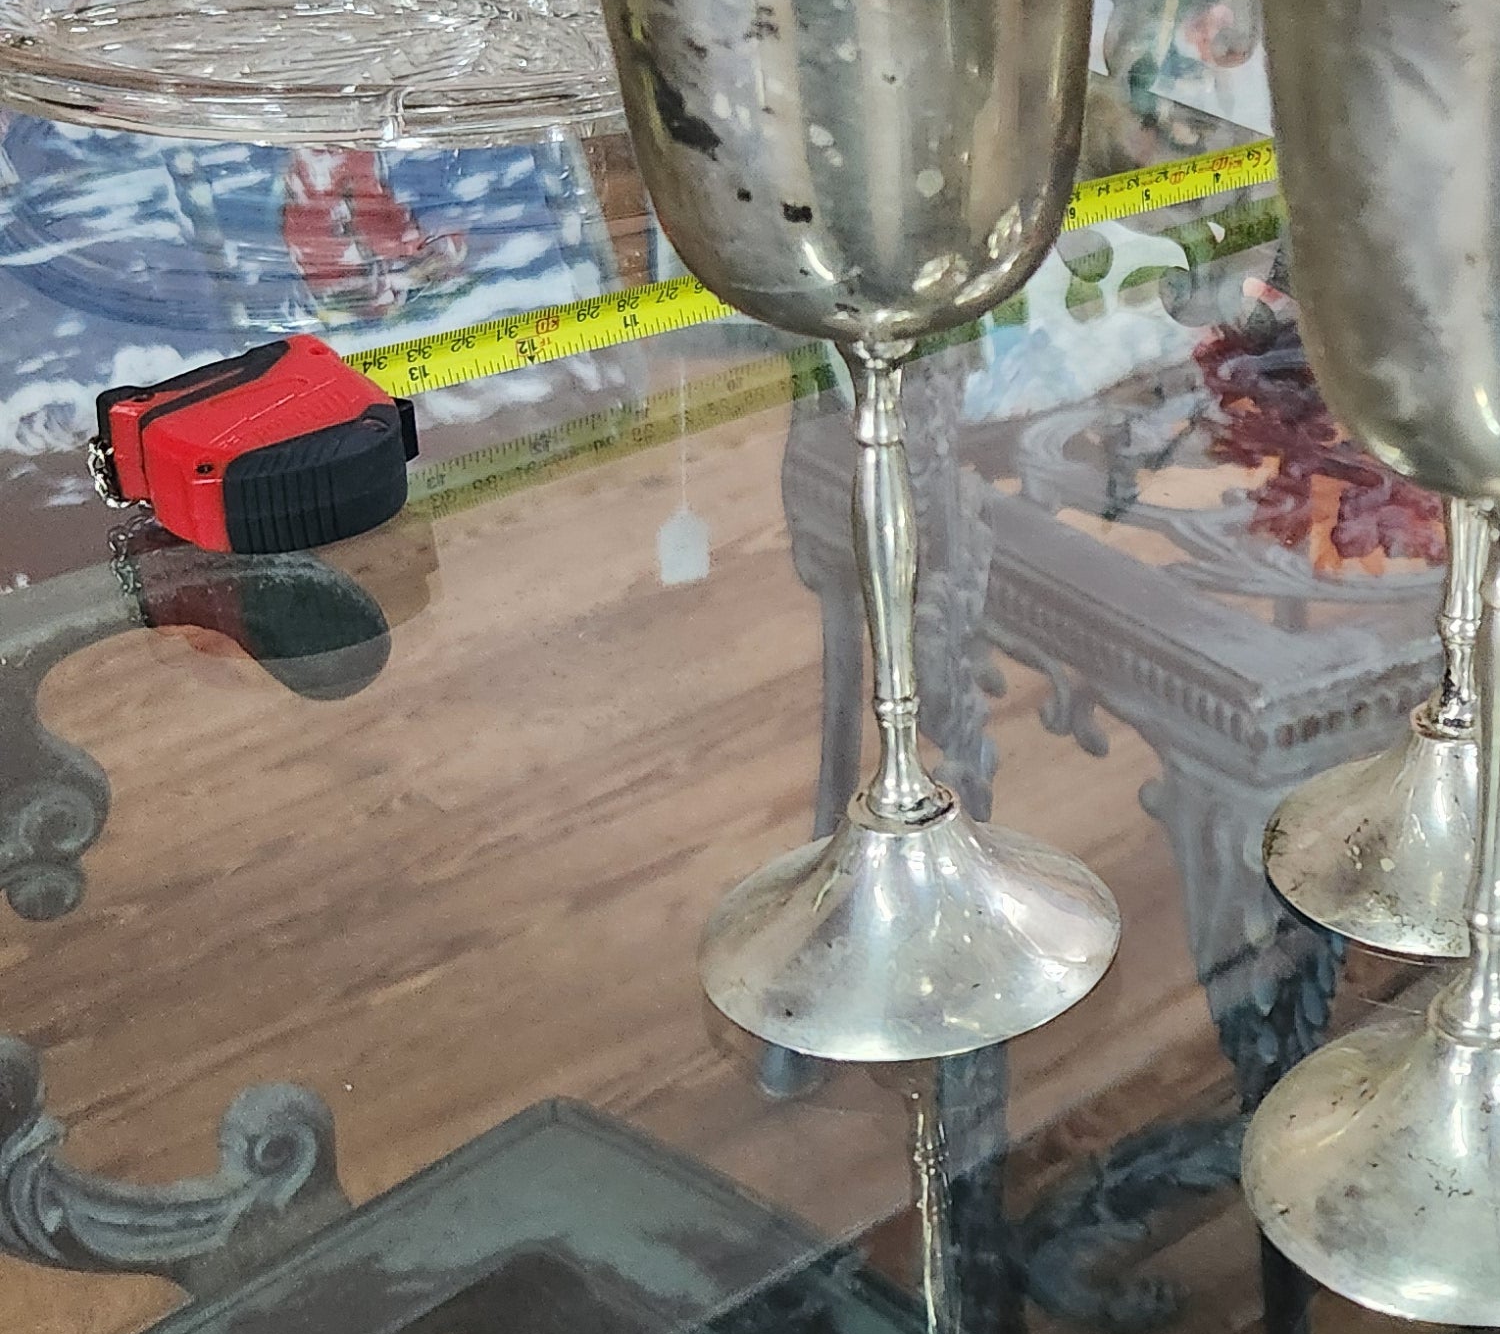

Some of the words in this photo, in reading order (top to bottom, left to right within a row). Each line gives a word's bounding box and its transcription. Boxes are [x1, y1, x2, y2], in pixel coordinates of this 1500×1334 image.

[1144, 187, 1151, 201] 5
[1069, 207, 1076, 219] 6
[616, 295, 640, 313] 28
[655, 286, 679, 304] 27
[576, 304, 601, 323] 29
[623, 314, 640, 328] 11
[496, 324, 519, 342] 31
[450, 335, 477, 353] 32
[517, 338, 538, 355] 12
[406, 345, 433, 364] 33
[363, 355, 388, 374] 34
[408, 364, 430, 382] 13
